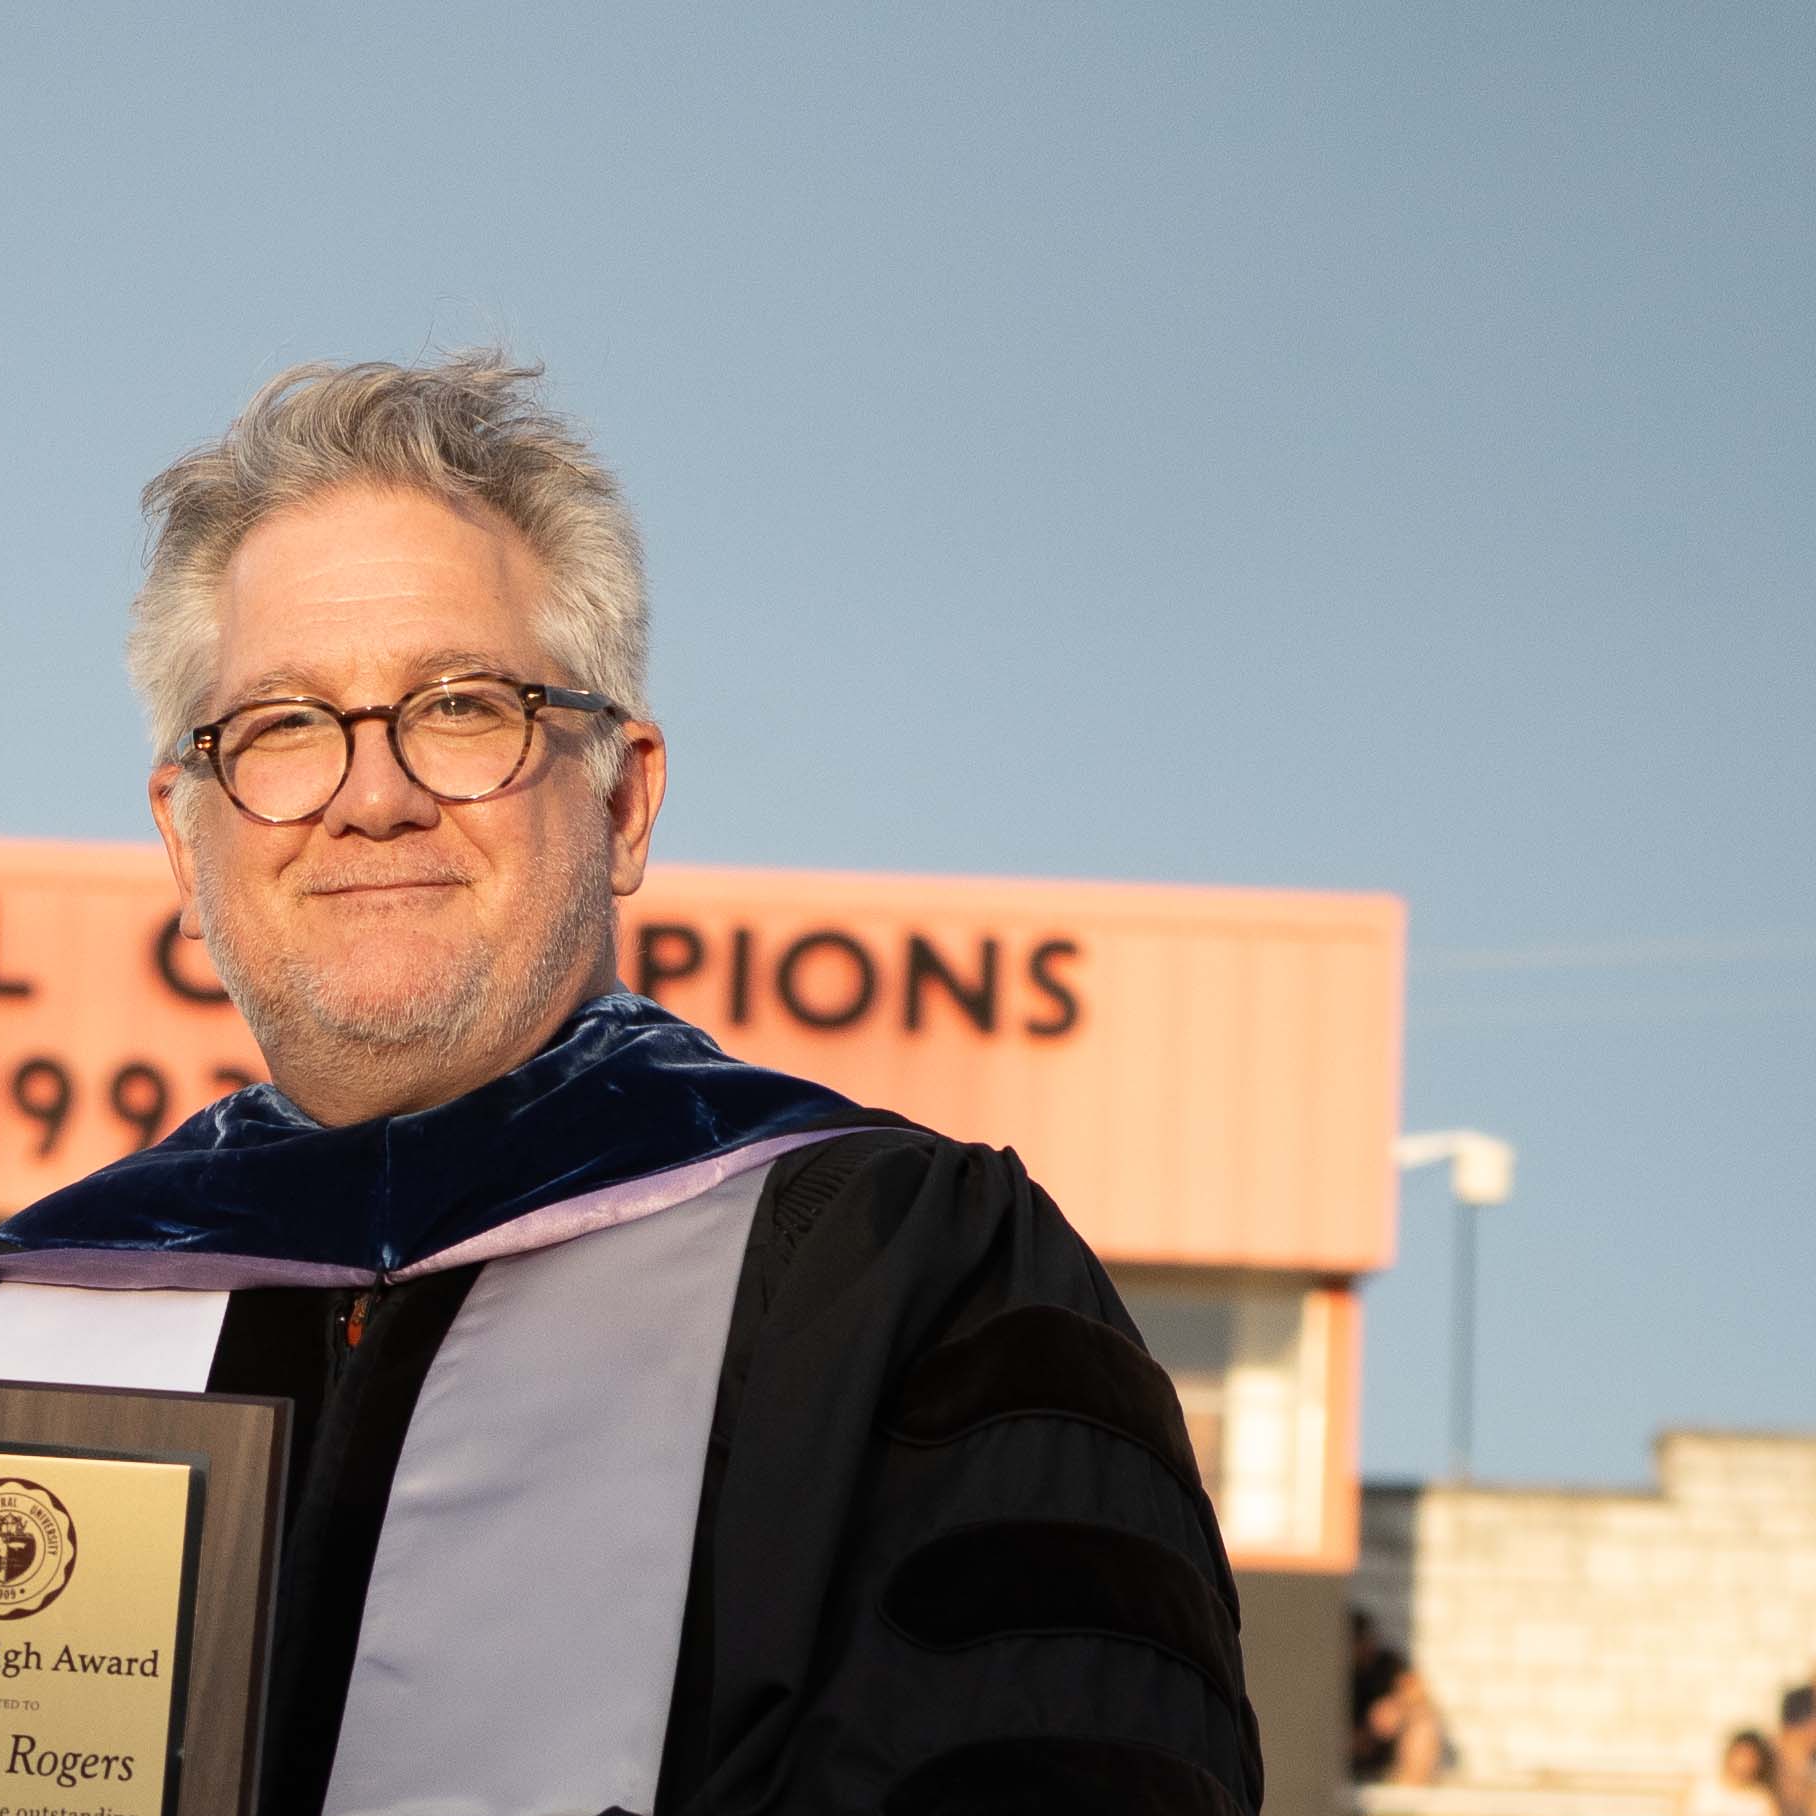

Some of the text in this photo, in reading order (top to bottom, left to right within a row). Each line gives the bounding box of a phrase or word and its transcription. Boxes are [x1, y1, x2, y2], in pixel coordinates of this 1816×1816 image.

[29, 1504, 59, 1557] UNIVERSITY
[51, 1643, 160, 1678] Award
[22, 1700, 41, 1712] TO
[5, 1733, 135, 1788] Rogers
